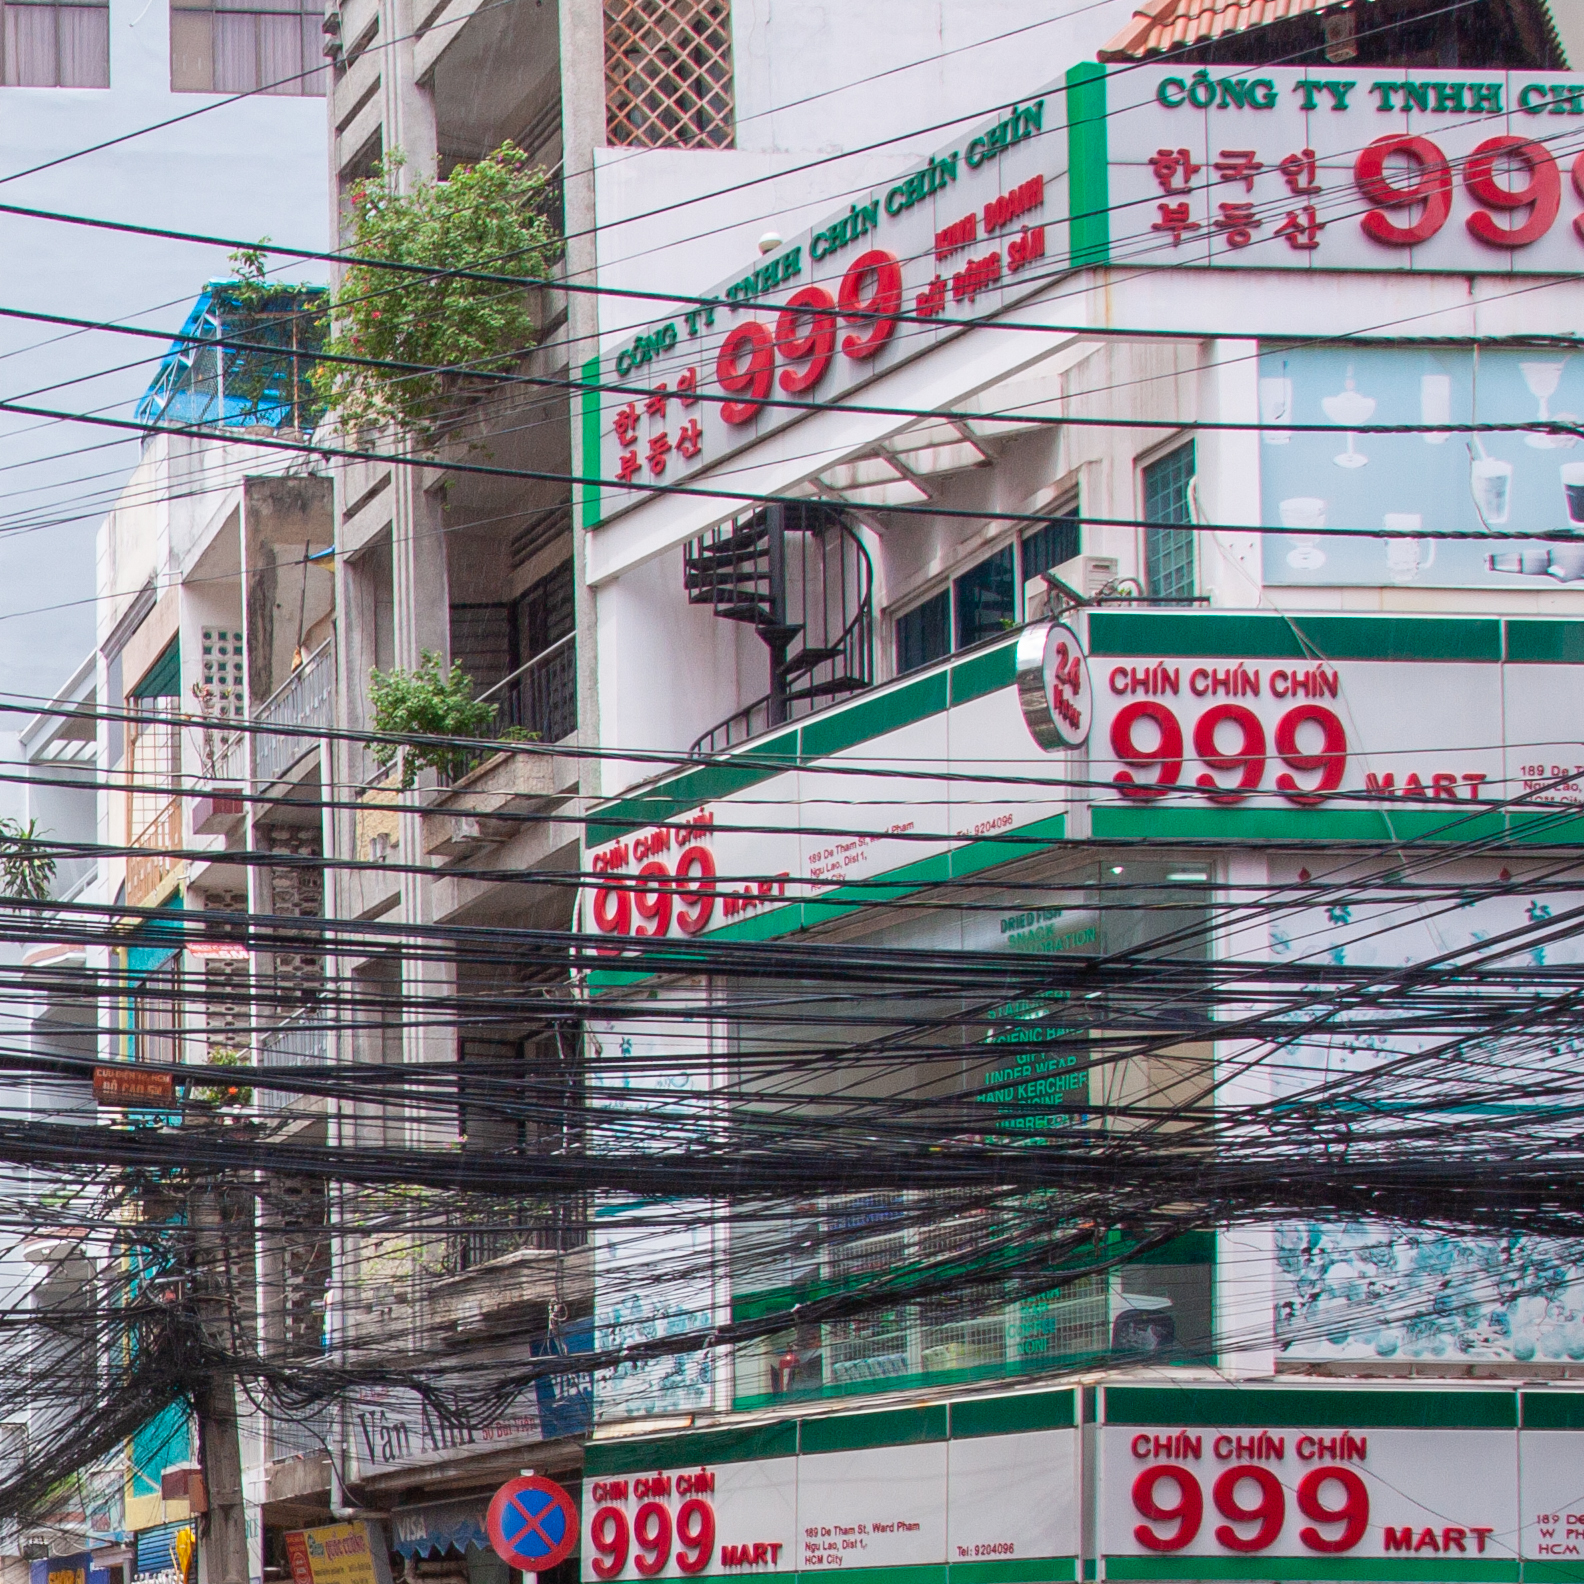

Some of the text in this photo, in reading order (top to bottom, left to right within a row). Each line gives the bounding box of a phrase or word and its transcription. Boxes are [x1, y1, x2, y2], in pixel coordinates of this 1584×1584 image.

[1156, 69, 1278, 111] CÔNG
[1293, 81, 1356, 111] TY
[1369, 81, 1504, 113] TNHH
[1148, 148, 1323, 195] 한국인
[1354, 133, 1584, 248] 99
[984, 173, 1045, 234] DOANH
[615, 99, 1045, 376] CÔNG TY TNHH CHÍN CHÍN CHÍN
[1150, 202, 1327, 251] 부동산
[716, 249, 903, 426] 999
[613, 367, 698, 447] 한국인
[615, 419, 703, 483] 부동산
[1055, 641, 1082, 696] 24
[1108, 660, 1340, 700] CHÍN CHÍN CHÍN
[1109, 700, 1348, 807] 999
[1520, 765, 1545, 776] 189
[1364, 772, 1488, 804] MART
[592, 807, 715, 875] CHÍN CHÍN CHÍN
[593, 845, 716, 957] 999
[1018, 1071, 1088, 1099] KERCHIEF
[1131, 1429, 1367, 1461] CHÍN CHÍN CHÍN
[805, 1525, 819, 1539] 189
[821, 1525, 832, 1538] De
[834, 1523, 856, 1537] Tham
[873, 1520, 894, 1534] Ward
[896, 1518, 920, 1533] Pham
[1131, 1464, 1370, 1553] 999
[1536, 1514, 1561, 1526] 189
[591, 1498, 716, 1580] 999
[721, 1542, 784, 1567] MART
[805, 1541, 819, 1554] Ngu
[842, 1537, 858, 1550] Dist
[957, 1541, 1015, 1557] Tel: 9204096
[1383, 1526, 1494, 1553] MART
[1537, 1543, 1581, 1555] HCM
[1539, 1528, 1556, 1539] W
[805, 1553, 843, 1567] HCM City
